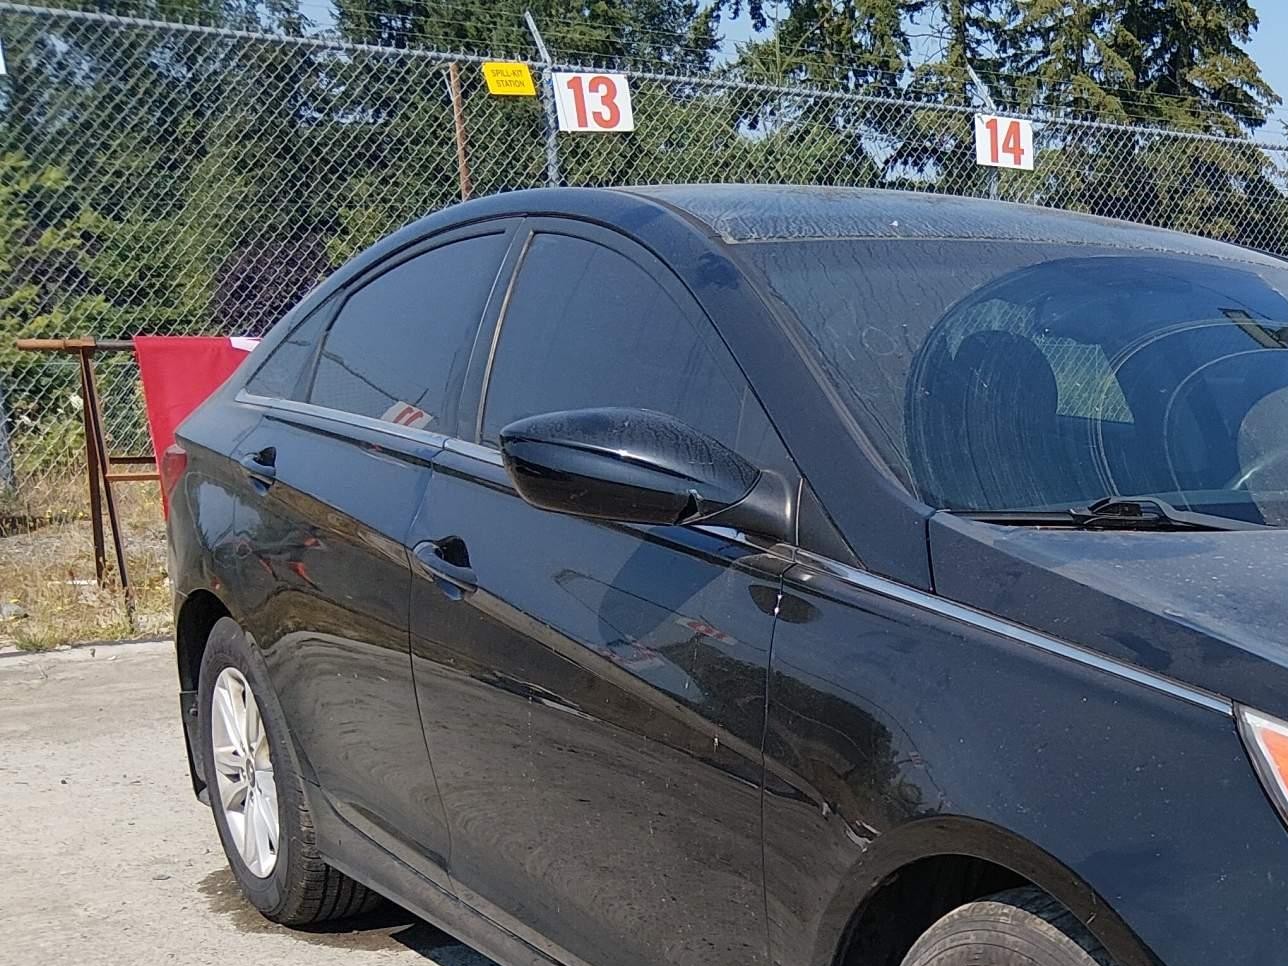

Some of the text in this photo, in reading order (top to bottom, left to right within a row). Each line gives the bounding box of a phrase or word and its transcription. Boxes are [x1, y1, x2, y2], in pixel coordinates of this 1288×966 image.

[496, 79, 525, 88] STATION
[567, 75, 621, 129] 13
[985, 118, 1025, 166] 14
